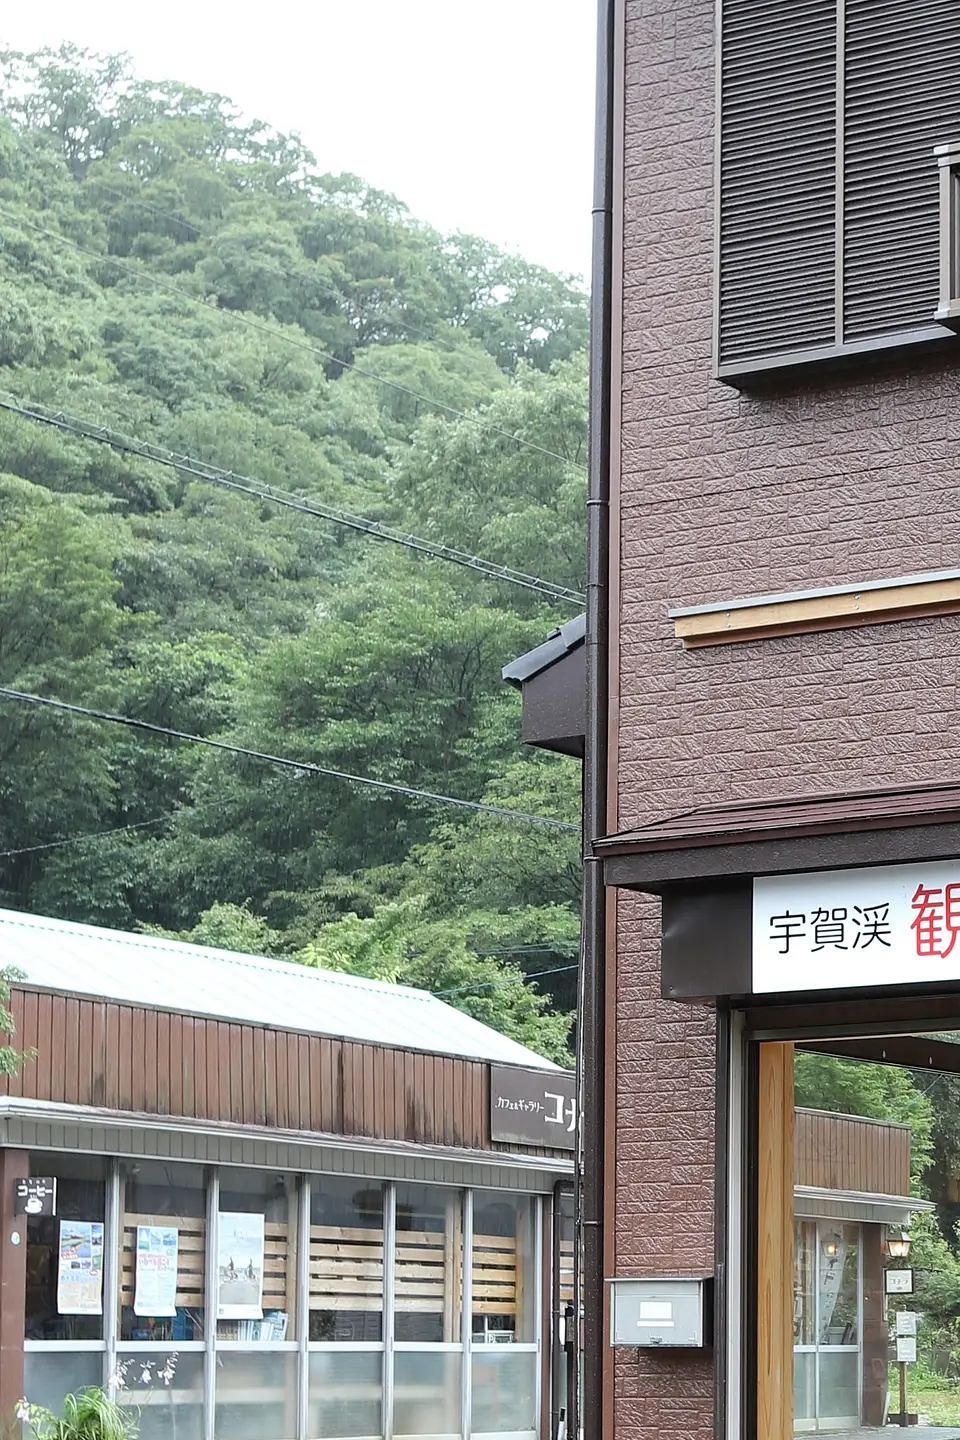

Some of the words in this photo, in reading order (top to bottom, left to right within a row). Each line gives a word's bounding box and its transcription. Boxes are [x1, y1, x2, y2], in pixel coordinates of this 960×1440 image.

[769, 903, 892, 954] 宇賀渓
[17, 1185, 53, 1197] コーヒー
